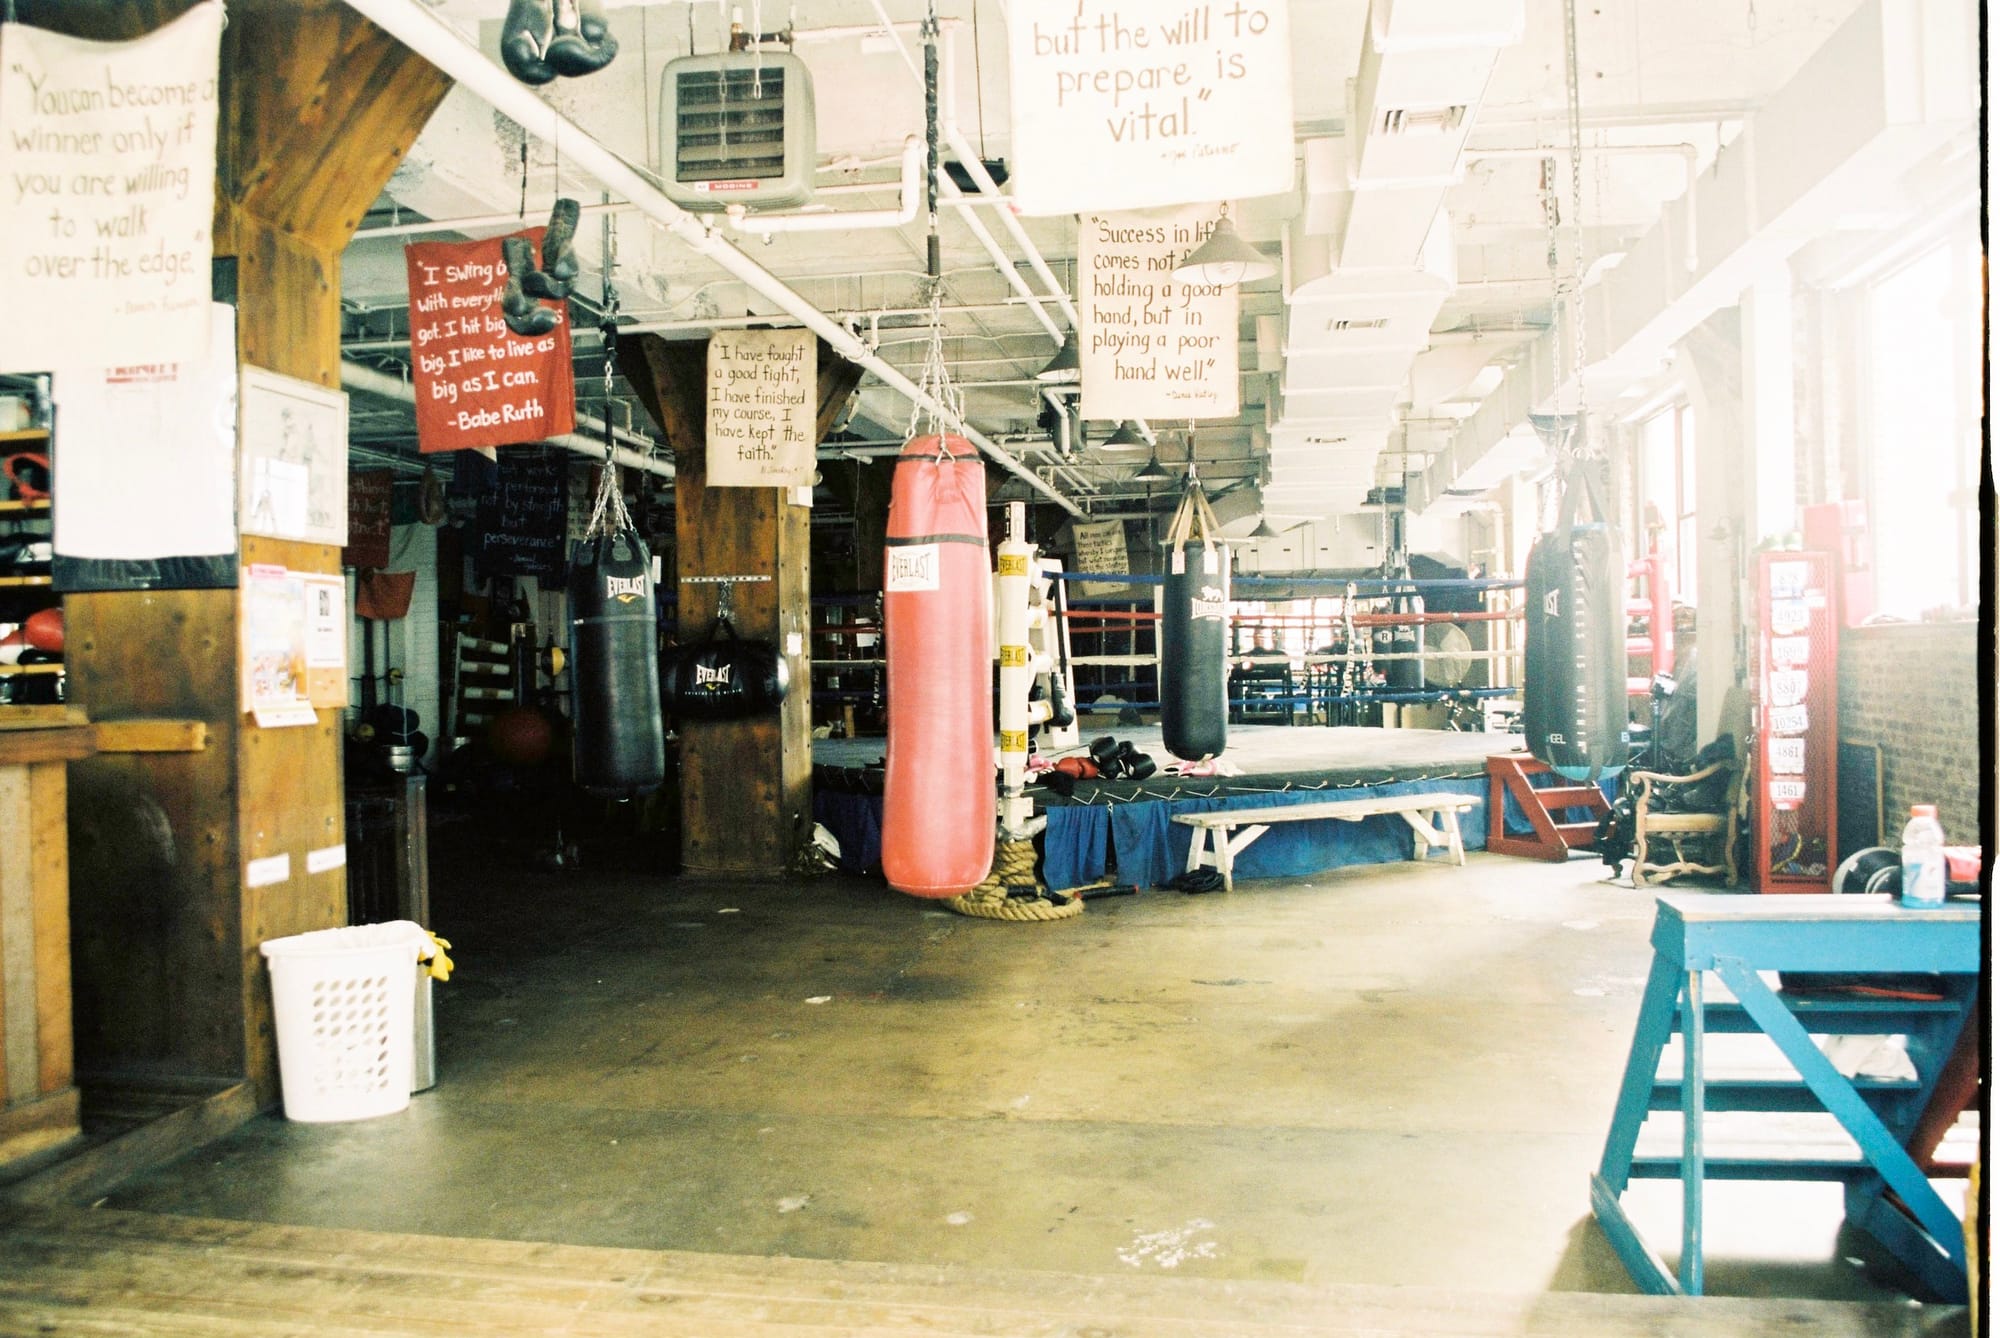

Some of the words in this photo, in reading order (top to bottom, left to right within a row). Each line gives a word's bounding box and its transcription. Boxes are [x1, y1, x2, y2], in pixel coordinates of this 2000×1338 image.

[1034, 15, 1087, 56] but
[1095, 12, 1150, 52] the
[1160, 5, 1210, 45] will
[1224, 2, 1269, 37] to
[105, 65, 196, 108] become
[1056, 62, 1191, 108] prepare
[1216, 50, 1247, 80] is
[1107, 88, 1213, 142] vital."
[12, 128, 103, 154] winner
[113, 117, 168, 160] only
[175, 112, 196, 144] if
[14, 171, 61, 199] you
[72, 172, 114, 195] are
[125, 164, 189, 199] willing
[50, 208, 76, 237] to
[95, 206, 147, 240] walk
[1091, 217, 1166, 244] "Success
[1174, 224, 1190, 242] in
[1195, 220, 1213, 242] lif
[25, 254, 85, 278] over
[92, 247, 132, 277] the
[1094, 254, 1140, 270] comes
[1148, 250, 1176, 271] not
[1093, 273, 1154, 305] holding
[1162, 284, 1172, 297] a
[1181, 284, 1222, 309] good
[1093, 304, 1138, 327] hand,
[1143, 304, 1172, 325] but
[1185, 307, 1202, 326] in
[417, 324, 442, 346] got.
[445, 321, 457, 337] I
[462, 316, 480, 335] hit
[485, 316, 507, 339] big
[1092, 328, 1150, 356] playing
[1157, 335, 1167, 347] a
[1178, 335, 1220, 355] poor
[448, 350, 461, 367] I
[463, 347, 485, 363] like
[488, 345, 505, 360] to
[507, 340, 533, 358] live
[537, 337, 555, 352] as
[735, 345, 764, 361] have
[768, 344, 806, 366] fought
[715, 369, 722, 378] a
[728, 365, 757, 386] good
[1114, 357, 1156, 381] hand
[432, 380, 457, 403] big
[462, 378, 482, 392] as
[483, 371, 499, 391] I
[711, 387, 721, 402] I
[725, 388, 750, 403] have
[754, 386, 806, 405] finished
[503, 399, 544, 423] Ruth
[713, 408, 729, 424] my
[781, 409, 792, 422] I
[715, 423, 744, 438] have
[748, 423, 775, 445] kept
[783, 426, 806, 442] the
[892, 552, 931, 581] EVERLAST
[606, 574, 646, 599] EVERLAST
[695, 663, 732, 685] EVERLAST
[1776, 784, 1799, 797] 1461
